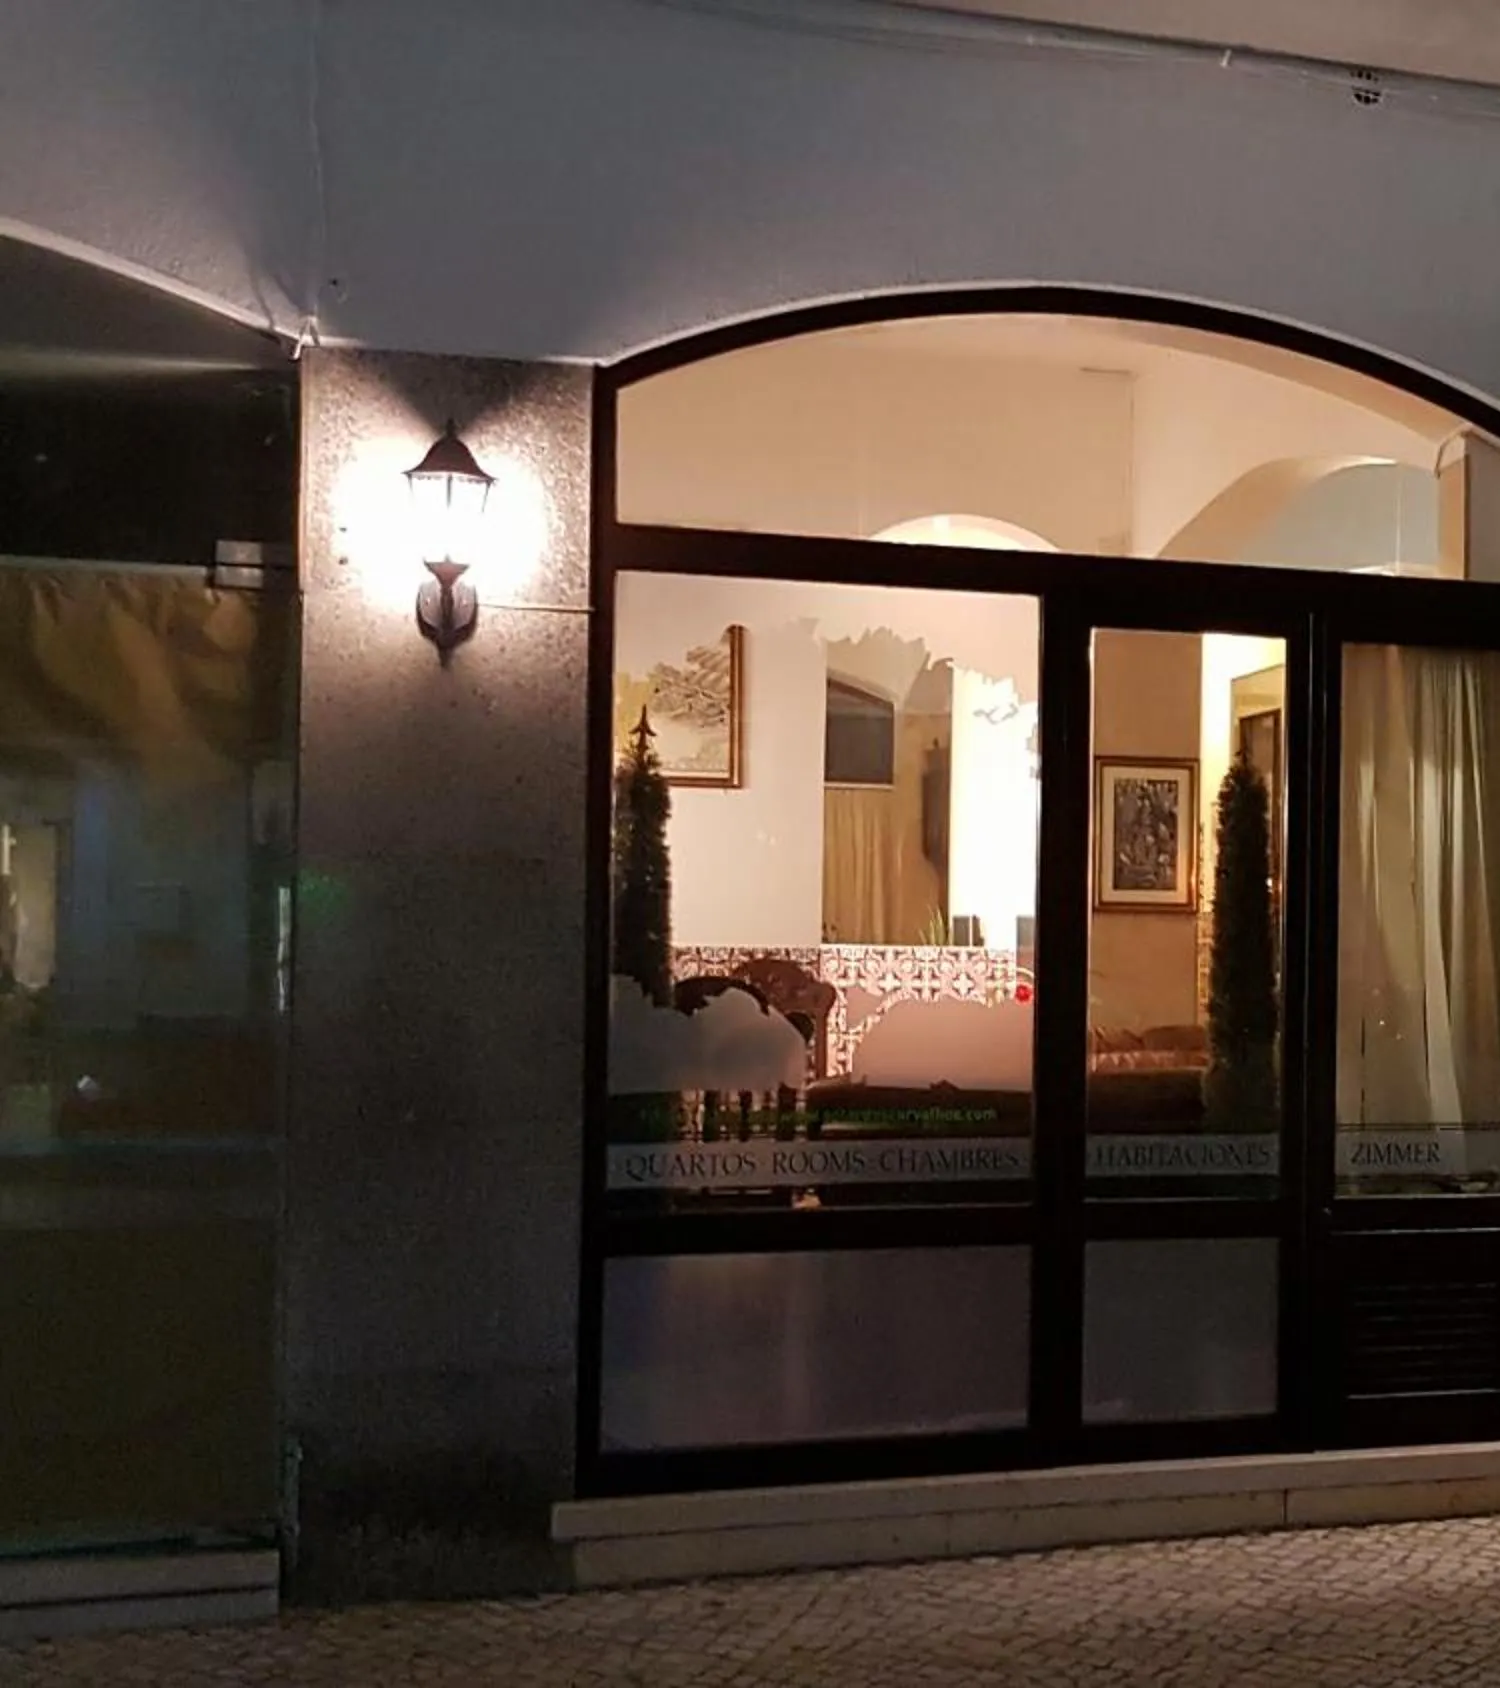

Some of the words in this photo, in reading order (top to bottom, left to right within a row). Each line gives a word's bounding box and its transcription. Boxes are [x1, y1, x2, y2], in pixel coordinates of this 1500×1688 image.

[625, 1150, 756, 1182] QUARTOS
[772, 1149, 866, 1175] ROOMS
[879, 1146, 1019, 1174] CHAMBRES
[1097, 1143, 1272, 1168] HABITACIONES
[1351, 1142, 1441, 1166] ZIMMER
